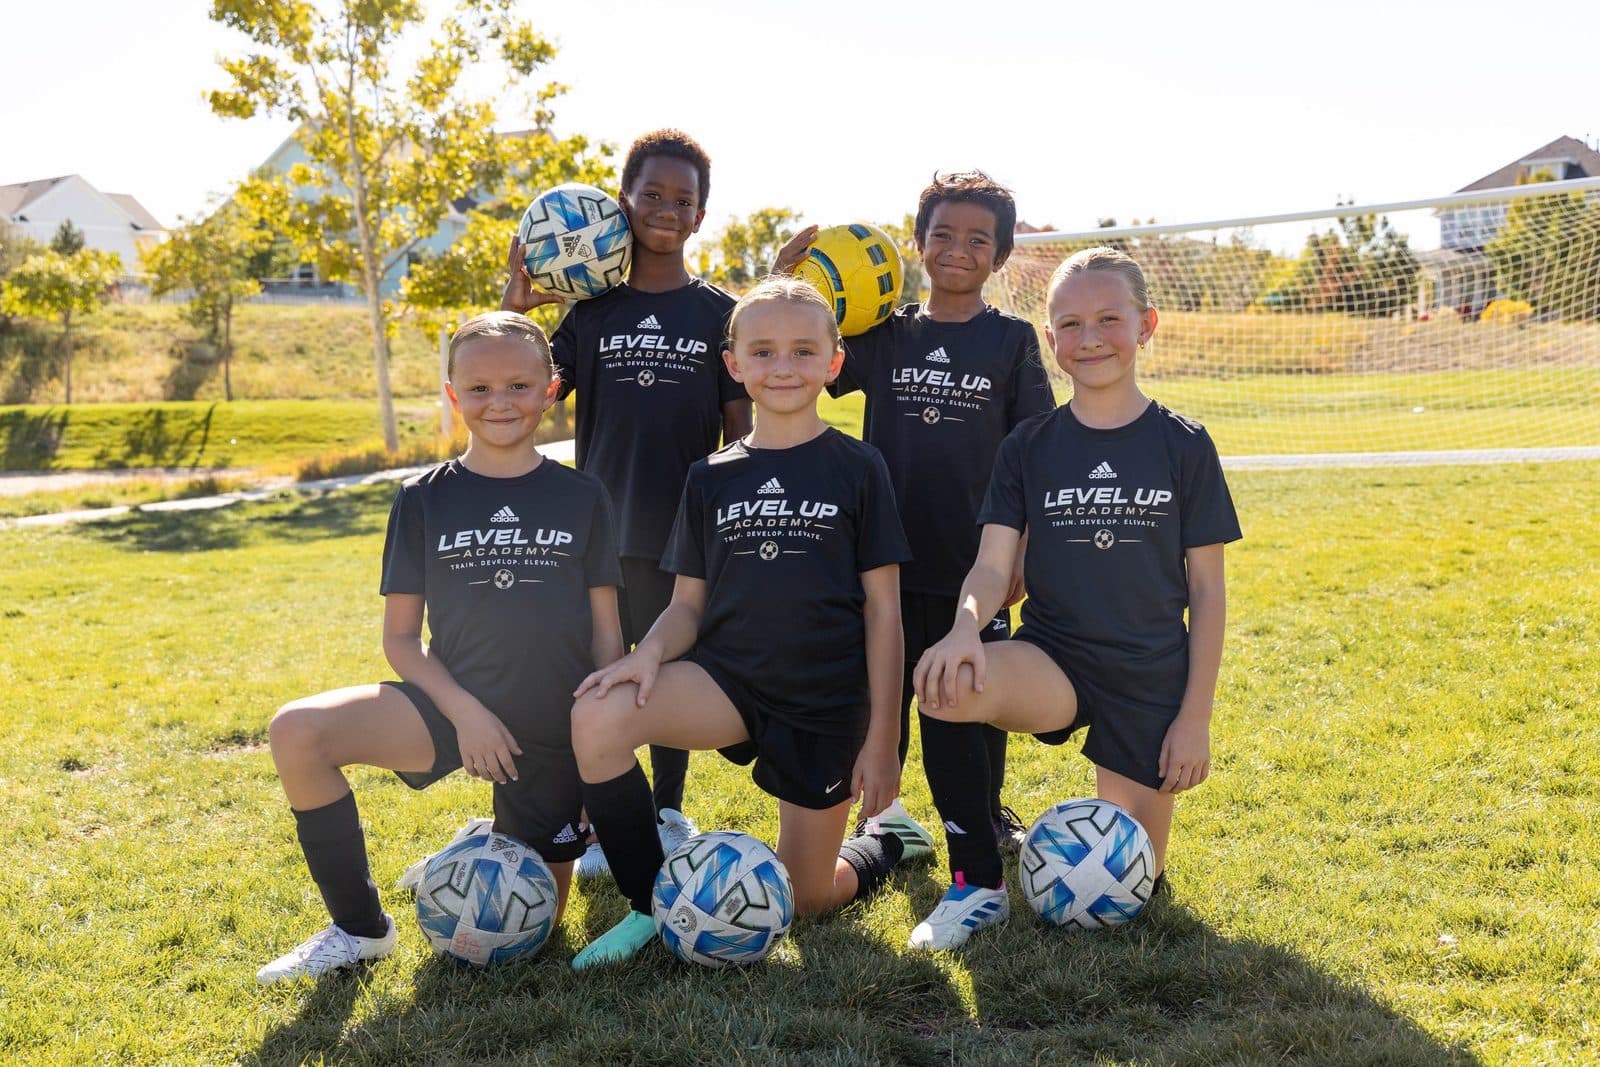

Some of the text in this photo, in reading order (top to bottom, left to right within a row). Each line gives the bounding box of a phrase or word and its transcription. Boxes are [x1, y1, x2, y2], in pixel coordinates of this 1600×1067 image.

[599, 334, 708, 355] LEVEL UP
[614, 350, 687, 361] ACADEMY
[925, 355, 951, 363] adidas
[664, 362, 697, 373] ELEVATE.
[892, 368, 992, 391] LEVEL UP
[904, 385, 973, 399] ACADEMY
[912, 396, 947, 404] DEVELOP.
[949, 400, 982, 410] ELEVATE.
[1044, 487, 1173, 509] LEVEL UP
[716, 499, 839, 526] LEVEL UP
[1063, 506, 1148, 516] ACADEMY
[733, 518, 813, 530] ACADEMY
[1051, 519, 1077, 527] TRAIN.
[1123, 519, 1159, 528] ELEVATE.
[437, 528, 574, 551] LEVEL UP
[788, 530, 824, 541] ELEVATE.
[462, 547, 550, 558] ACADEMY
[450, 558, 561, 570] TRAIN. DEVELOP. ELEVATE.
[552, 834, 578, 844] adidas
